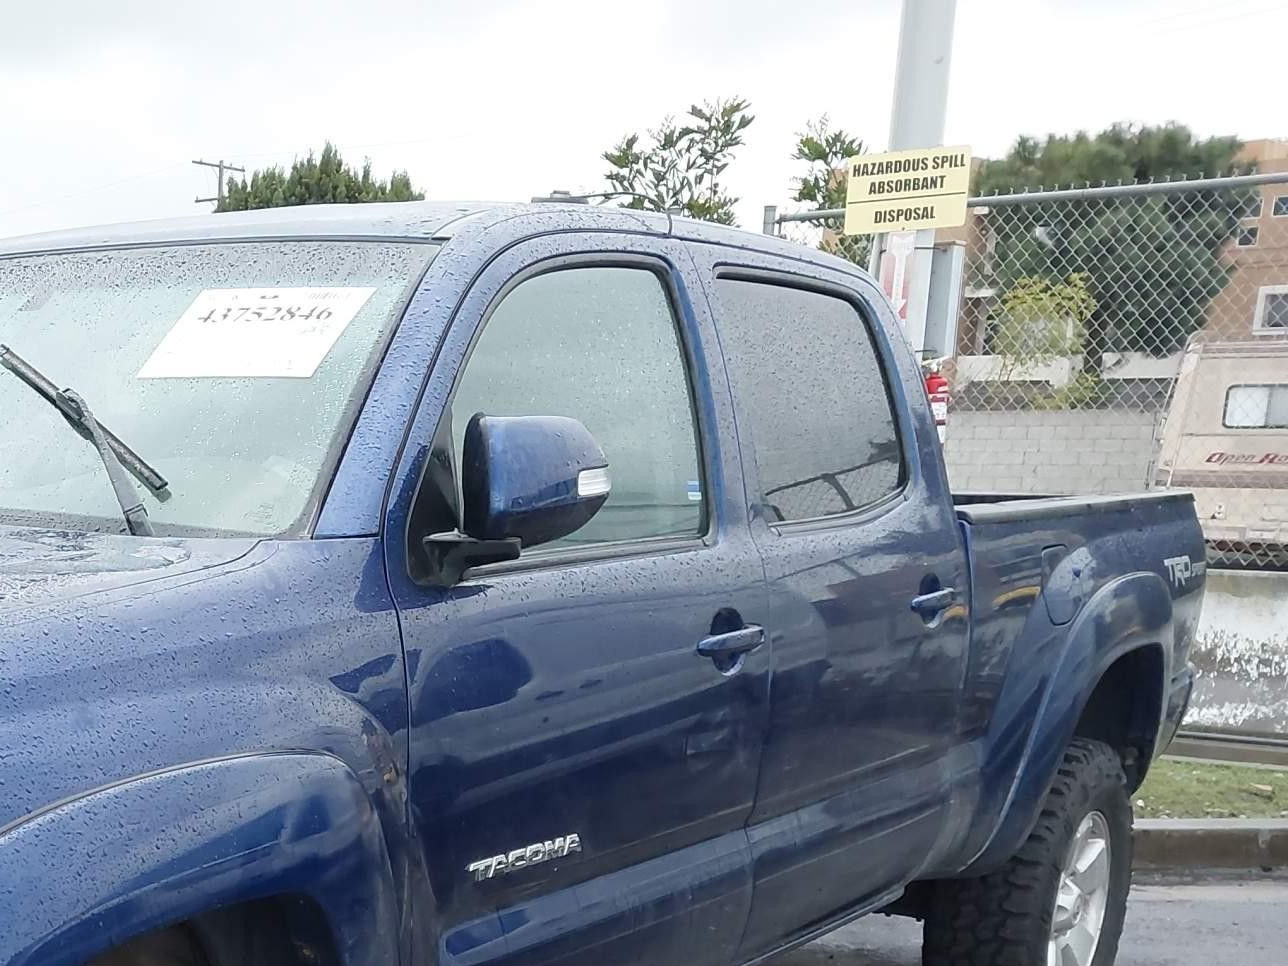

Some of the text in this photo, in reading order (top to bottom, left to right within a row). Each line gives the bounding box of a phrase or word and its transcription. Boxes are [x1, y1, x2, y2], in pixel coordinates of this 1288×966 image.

[852, 154, 966, 177] HAZARDOUS SPILL
[868, 175, 946, 195] ABSORBANT
[874, 206, 936, 224] DISPOSAL
[197, 305, 334, 323] 43752846
[1205, 452, 1257, 465] Open
[1163, 555, 1191, 588] TRD
[466, 833, 582, 881] TACOMA
